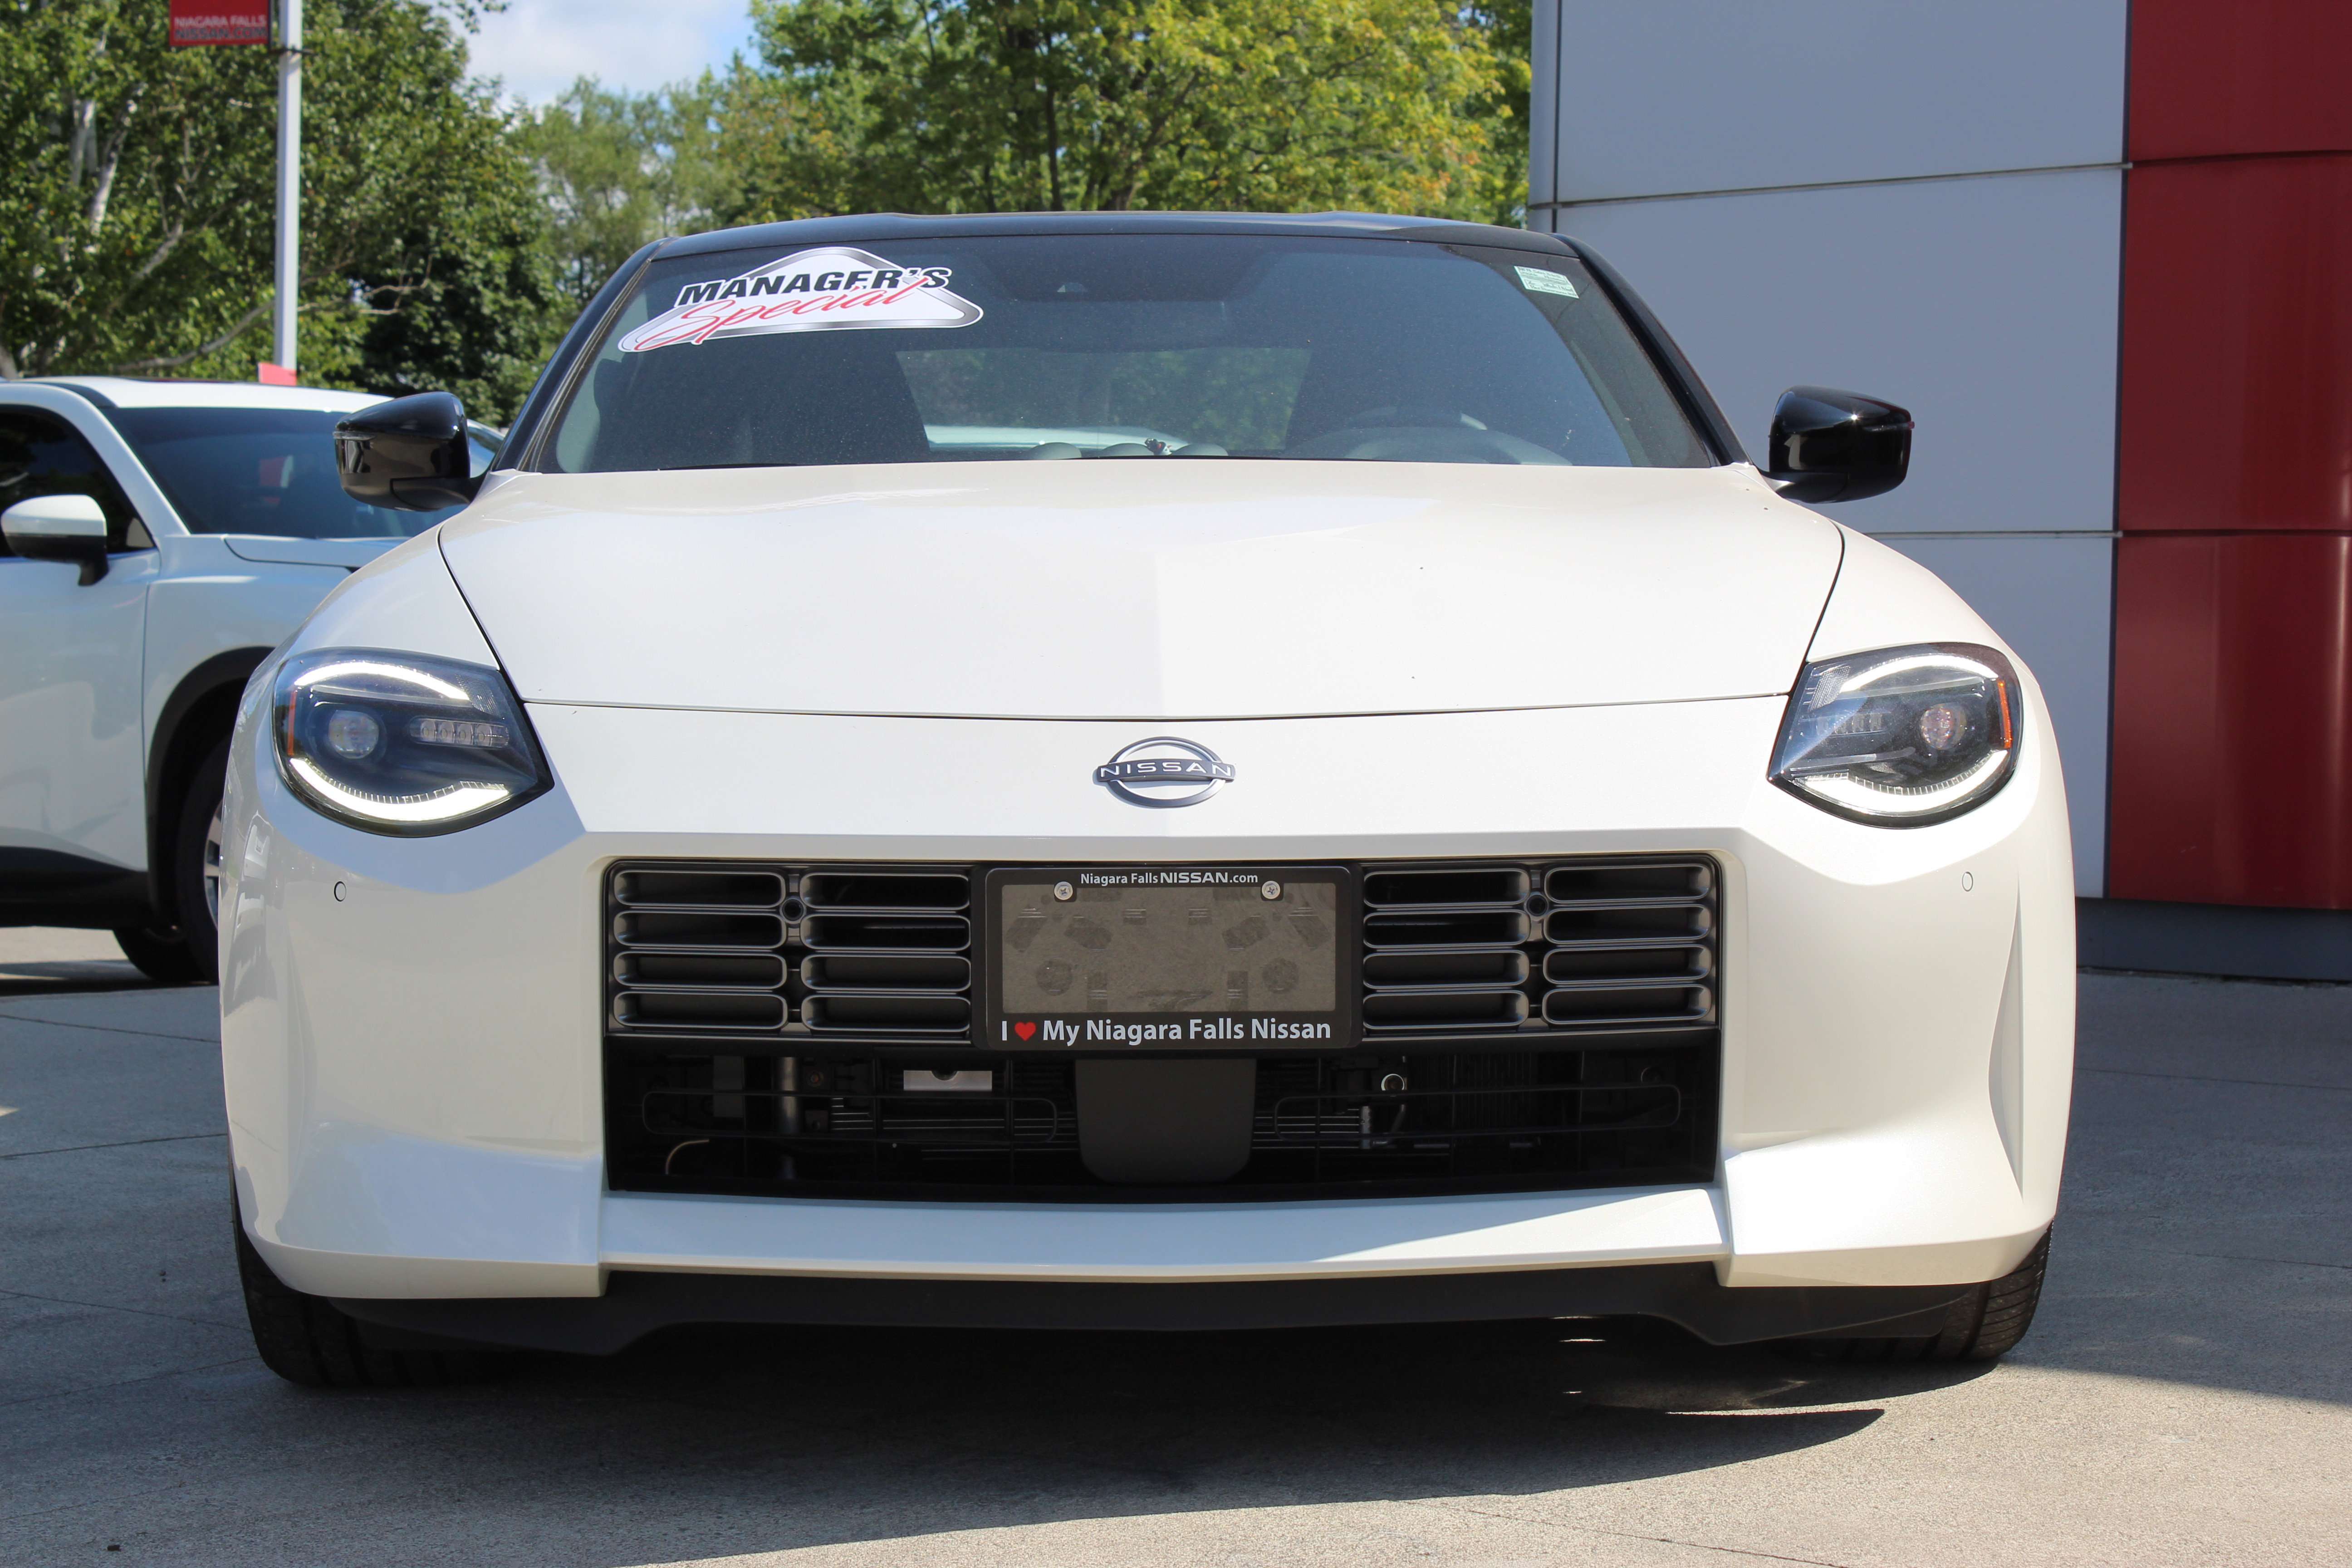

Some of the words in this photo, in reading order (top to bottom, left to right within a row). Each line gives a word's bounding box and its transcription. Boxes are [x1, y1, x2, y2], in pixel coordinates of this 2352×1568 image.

[174, 16, 227, 26] NIAGARA
[230, 15, 265, 26] FALLS
[175, 27, 267, 39] NISSAN.COM
[678, 269, 950, 305] MANAGER'S
[635, 278, 928, 350] Special
[1100, 761, 1231, 778] NISSAN
[1081, 873, 1127, 887] Niagara
[1131, 872, 1158, 883] Falls
[1160, 872, 1258, 883] NISSAN.com
[1002, 1020, 1007, 1041] I
[1043, 1020, 1080, 1047] My
[1087, 1019, 1182, 1046] Niagara
[1190, 1018, 1244, 1039] Falls
[1252, 1018, 1331, 1039] Nissan
